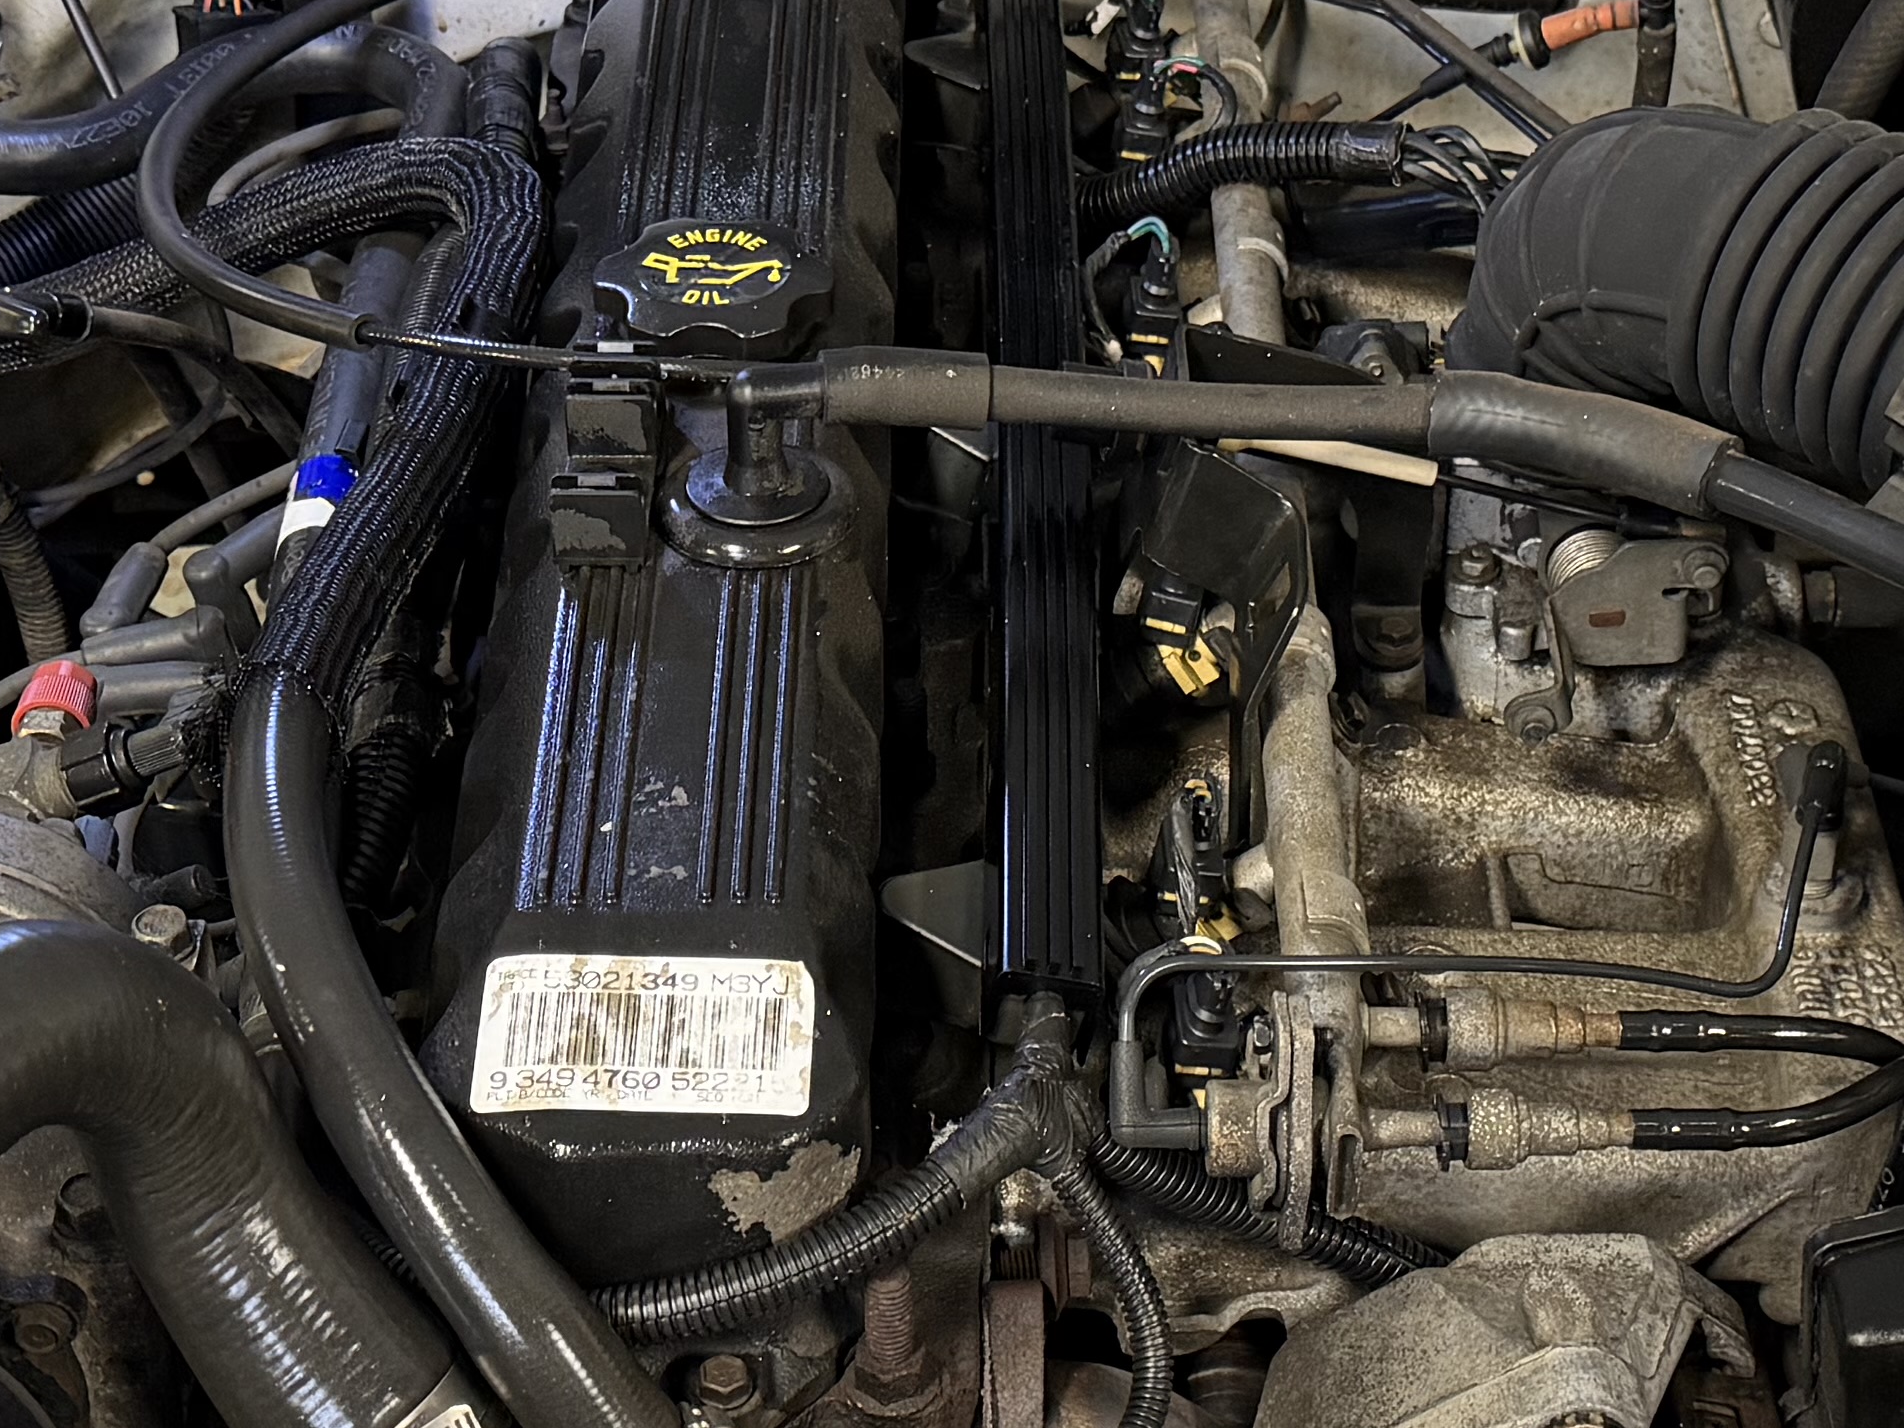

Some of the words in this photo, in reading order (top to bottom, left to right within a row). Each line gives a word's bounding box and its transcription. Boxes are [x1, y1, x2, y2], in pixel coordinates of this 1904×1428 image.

[667, 228, 768, 251] ENGINE
[681, 289, 730, 305] OIL
[516, 1069, 576, 1090] 349
[583, 1069, 662, 1090] 4760
